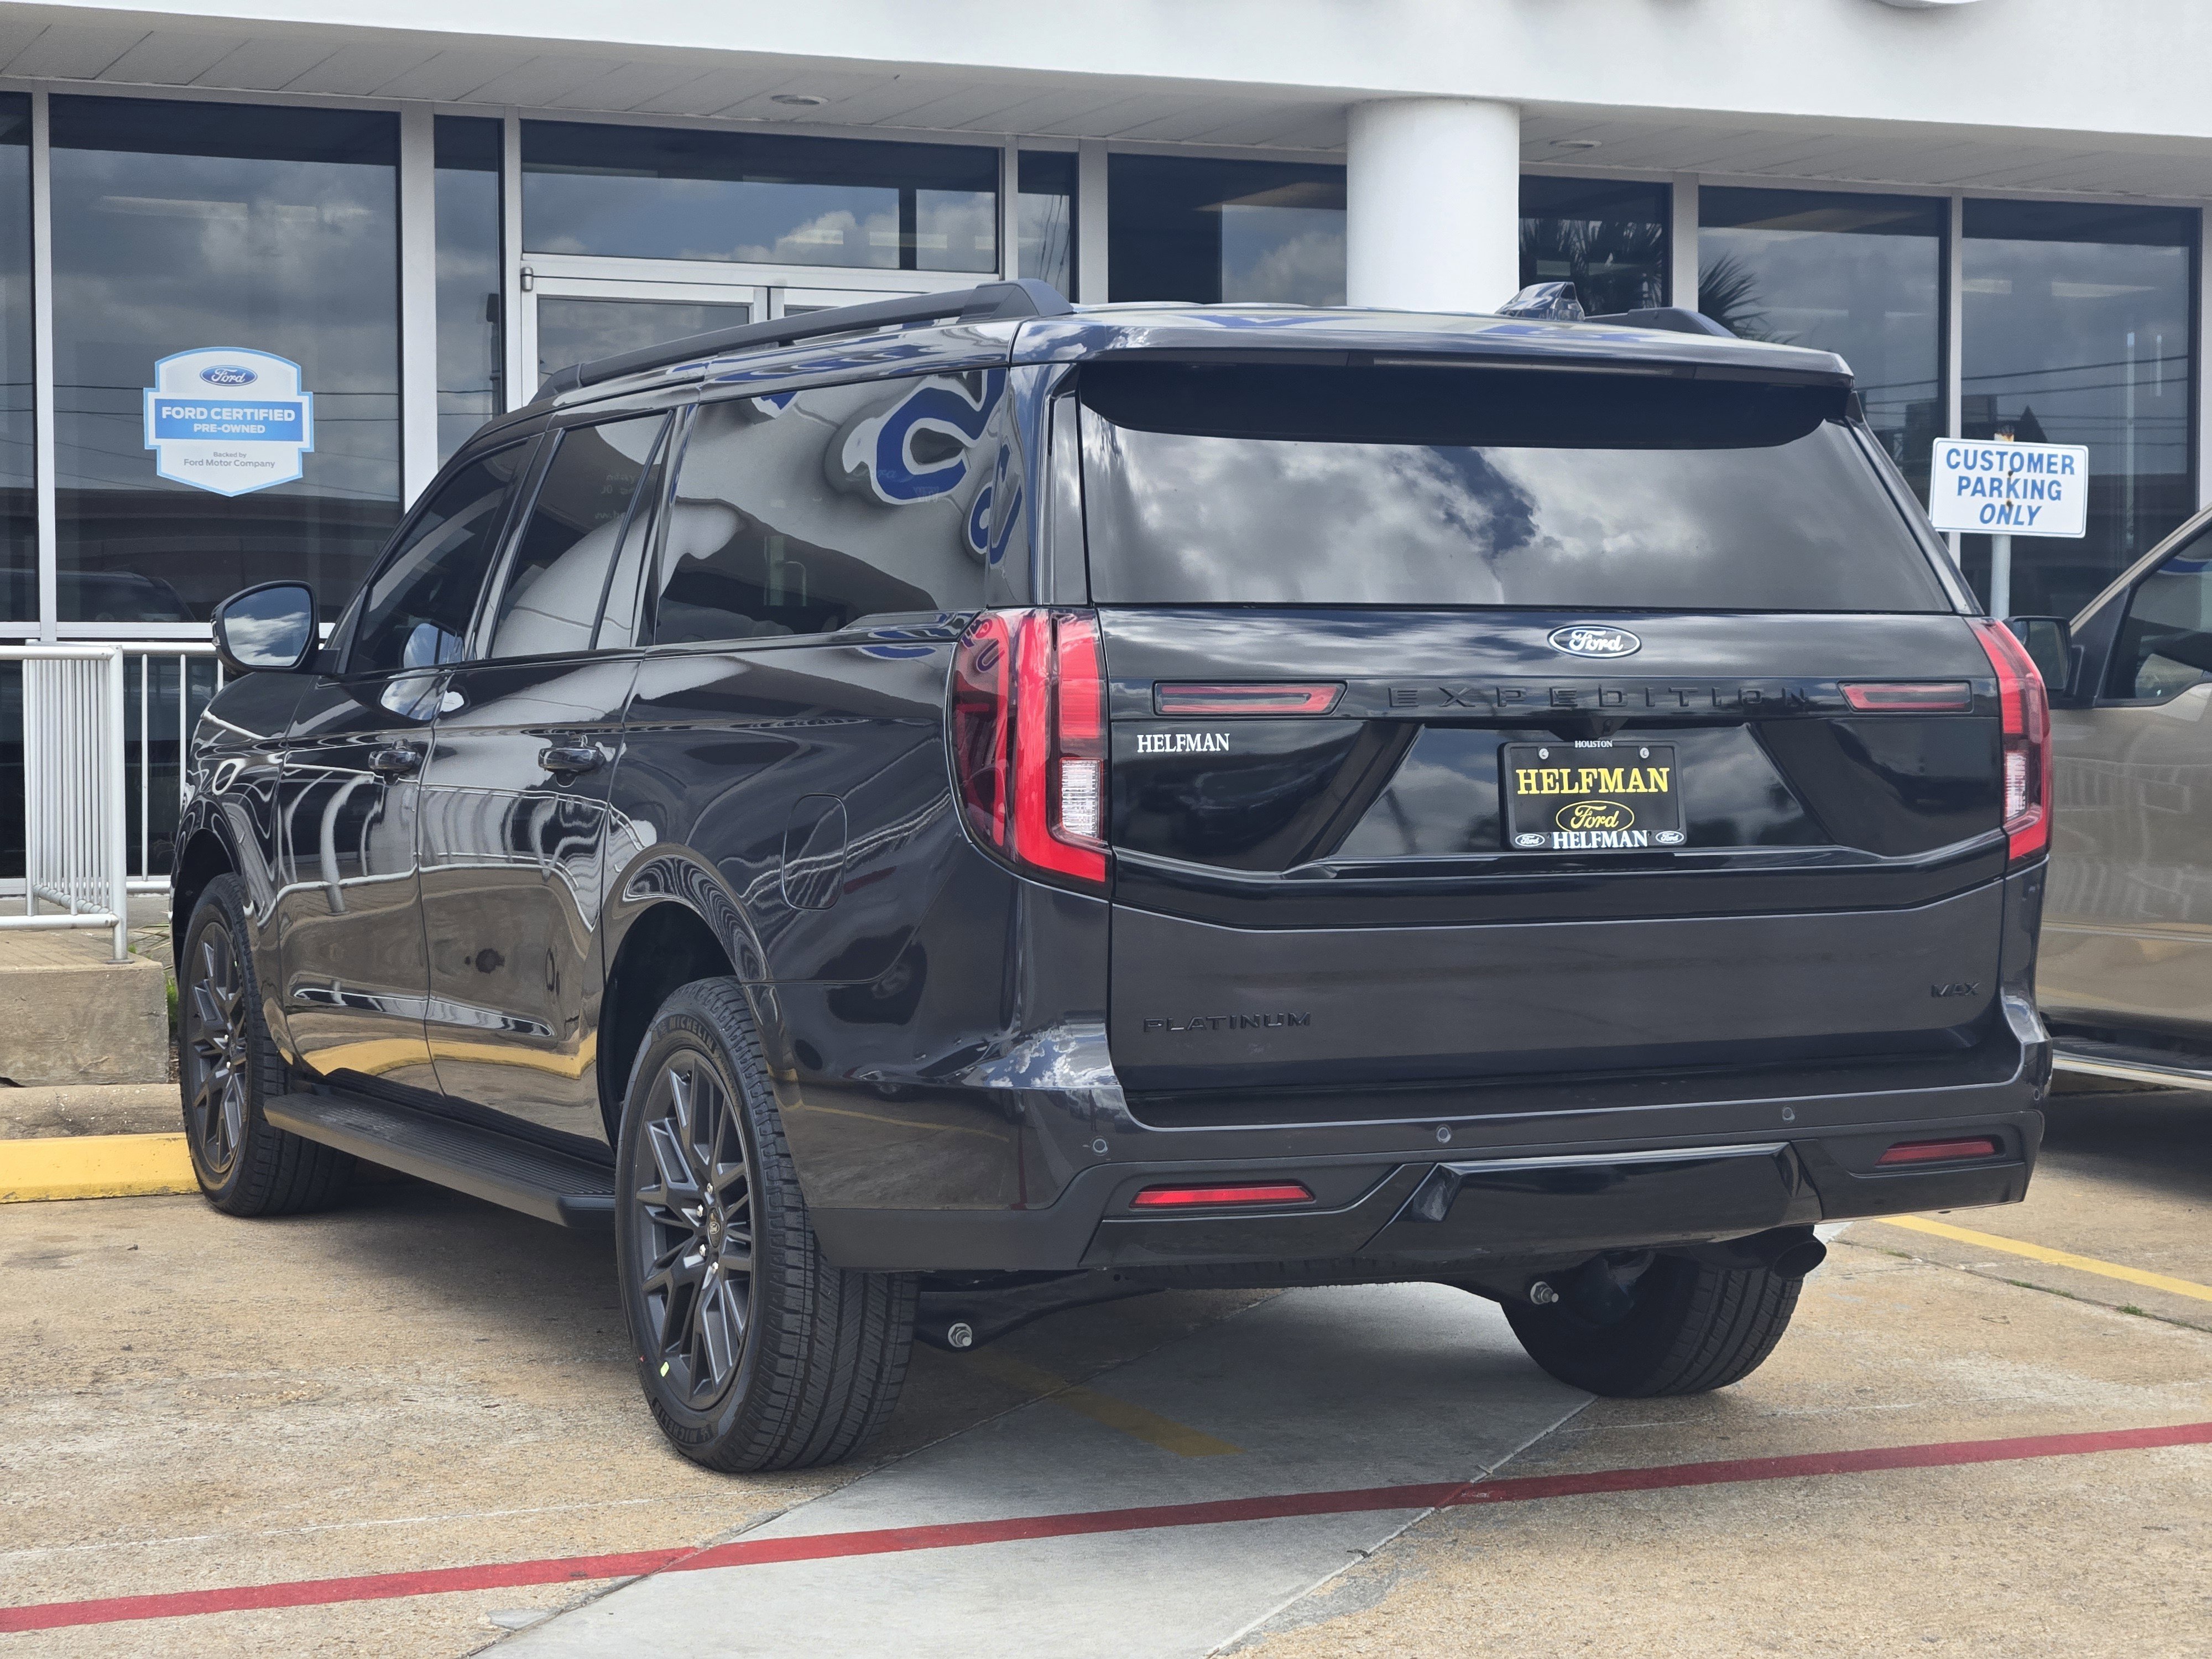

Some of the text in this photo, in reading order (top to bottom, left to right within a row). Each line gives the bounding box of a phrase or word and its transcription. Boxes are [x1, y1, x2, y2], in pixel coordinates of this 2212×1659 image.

[211, 368, 246, 382] Ford
[162, 407, 295, 421] FORD CERTIFIED
[194, 423, 265, 434] PRE-OWNED
[234, 460, 275, 468] Company
[1946, 448, 2075, 475] CUSTOMER
[1957, 476, 2062, 501] PARKING
[1979, 503, 2042, 526] ONLY
[1568, 629, 1624, 651] Ford
[1388, 685, 1809, 708] EXPEDITION
[1137, 733, 1230, 753] HELFMAN
[1516, 767, 1670, 795] HELFMAN
[1570, 805, 1620, 829] Ford
[1552, 830, 1650, 849] HELFMAN
[1144, 1011, 1311, 1032] PLATINUM
[669, 1016, 714, 1050] MICHELIN
